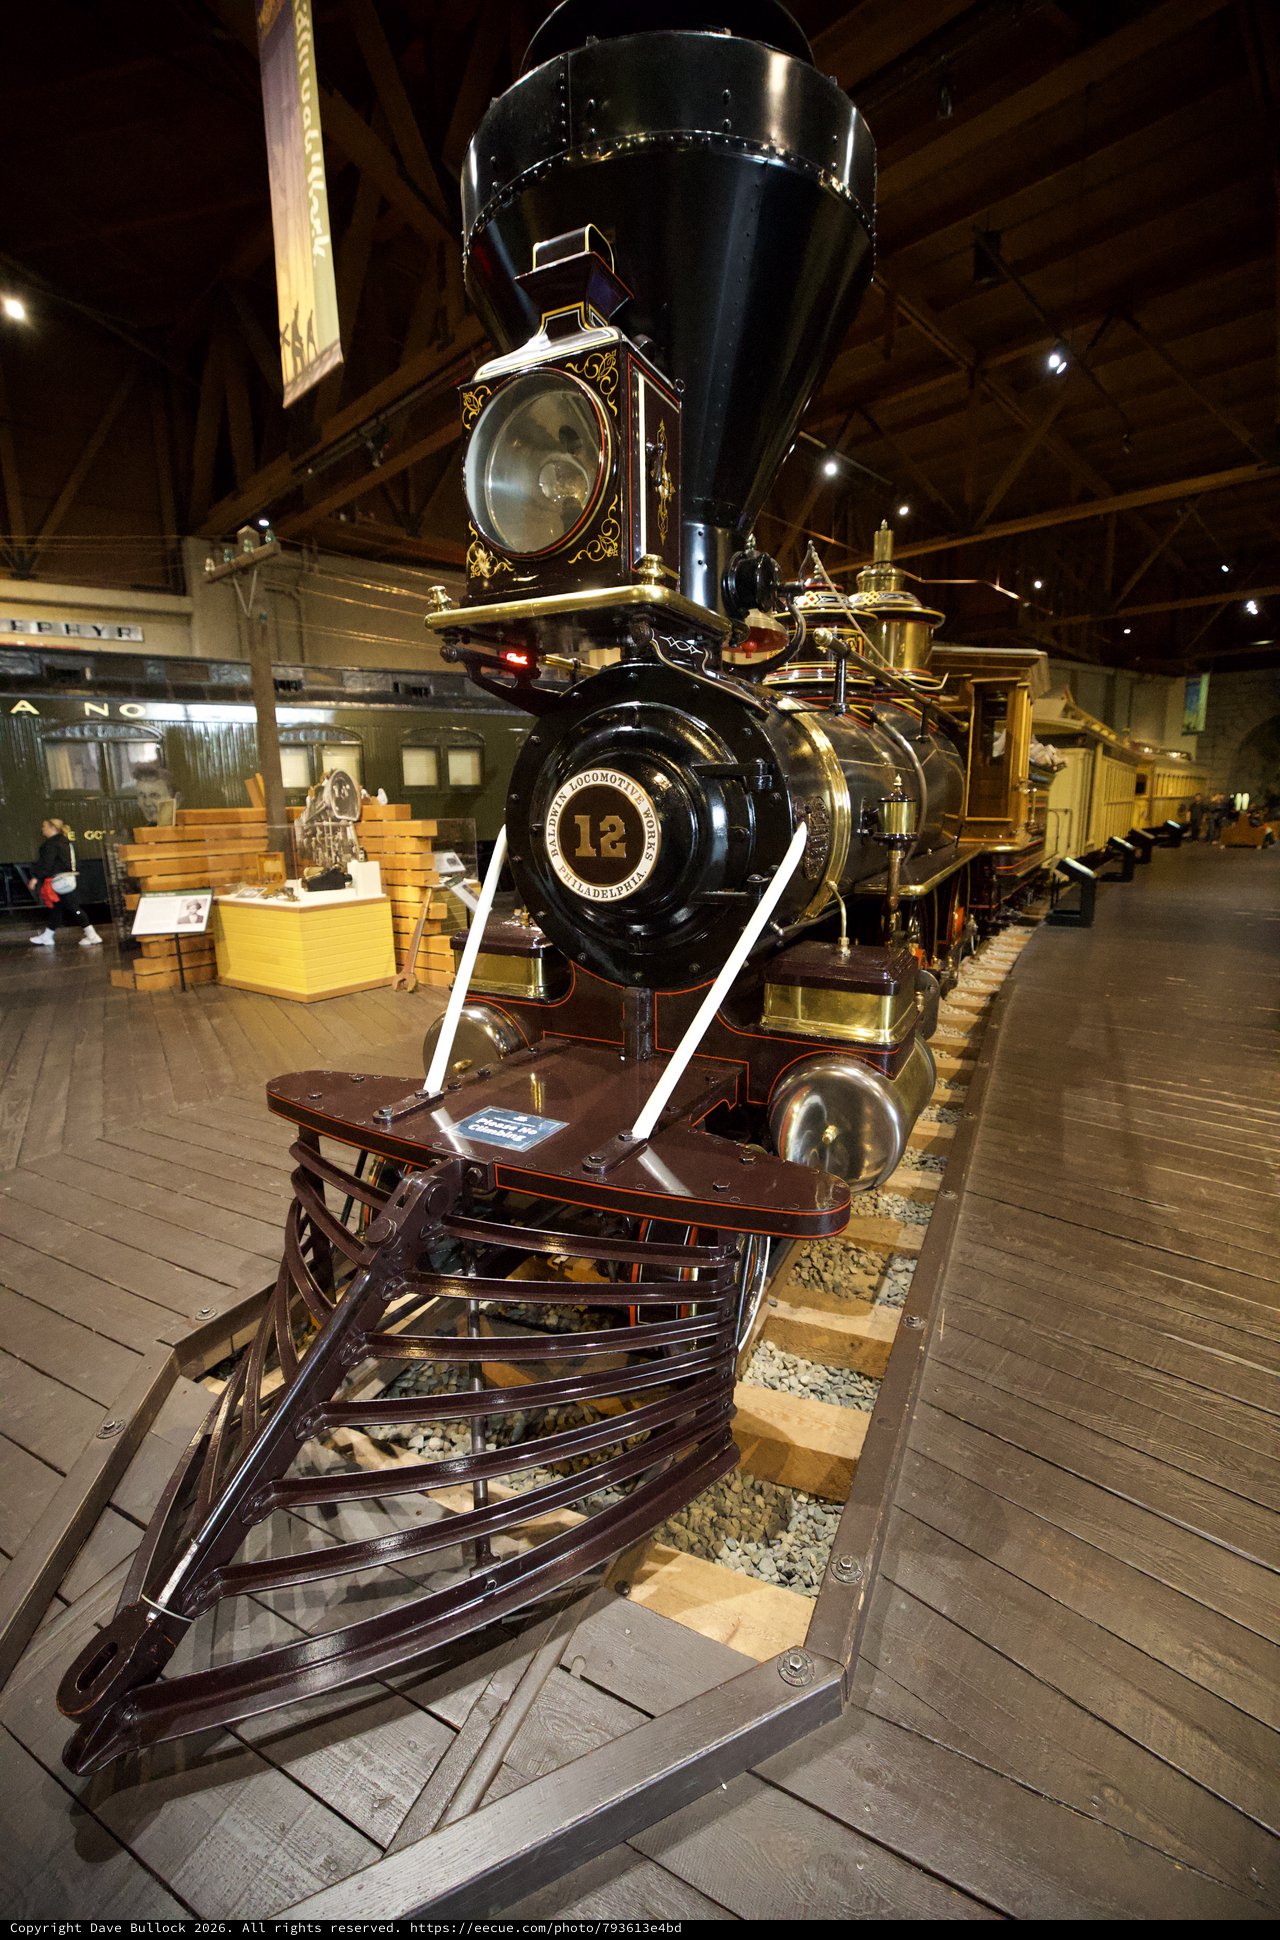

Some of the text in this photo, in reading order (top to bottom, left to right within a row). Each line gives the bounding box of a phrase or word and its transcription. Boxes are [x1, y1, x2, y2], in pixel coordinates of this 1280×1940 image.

[548, 772, 655, 861] BALDWIN LOCOMOTIVE WORKS
[573, 814, 627, 858] 12
[468, 1123, 527, 1142] Climbing
[475, 1117, 518, 1131] Please
[517, 1126, 538, 1135] No
